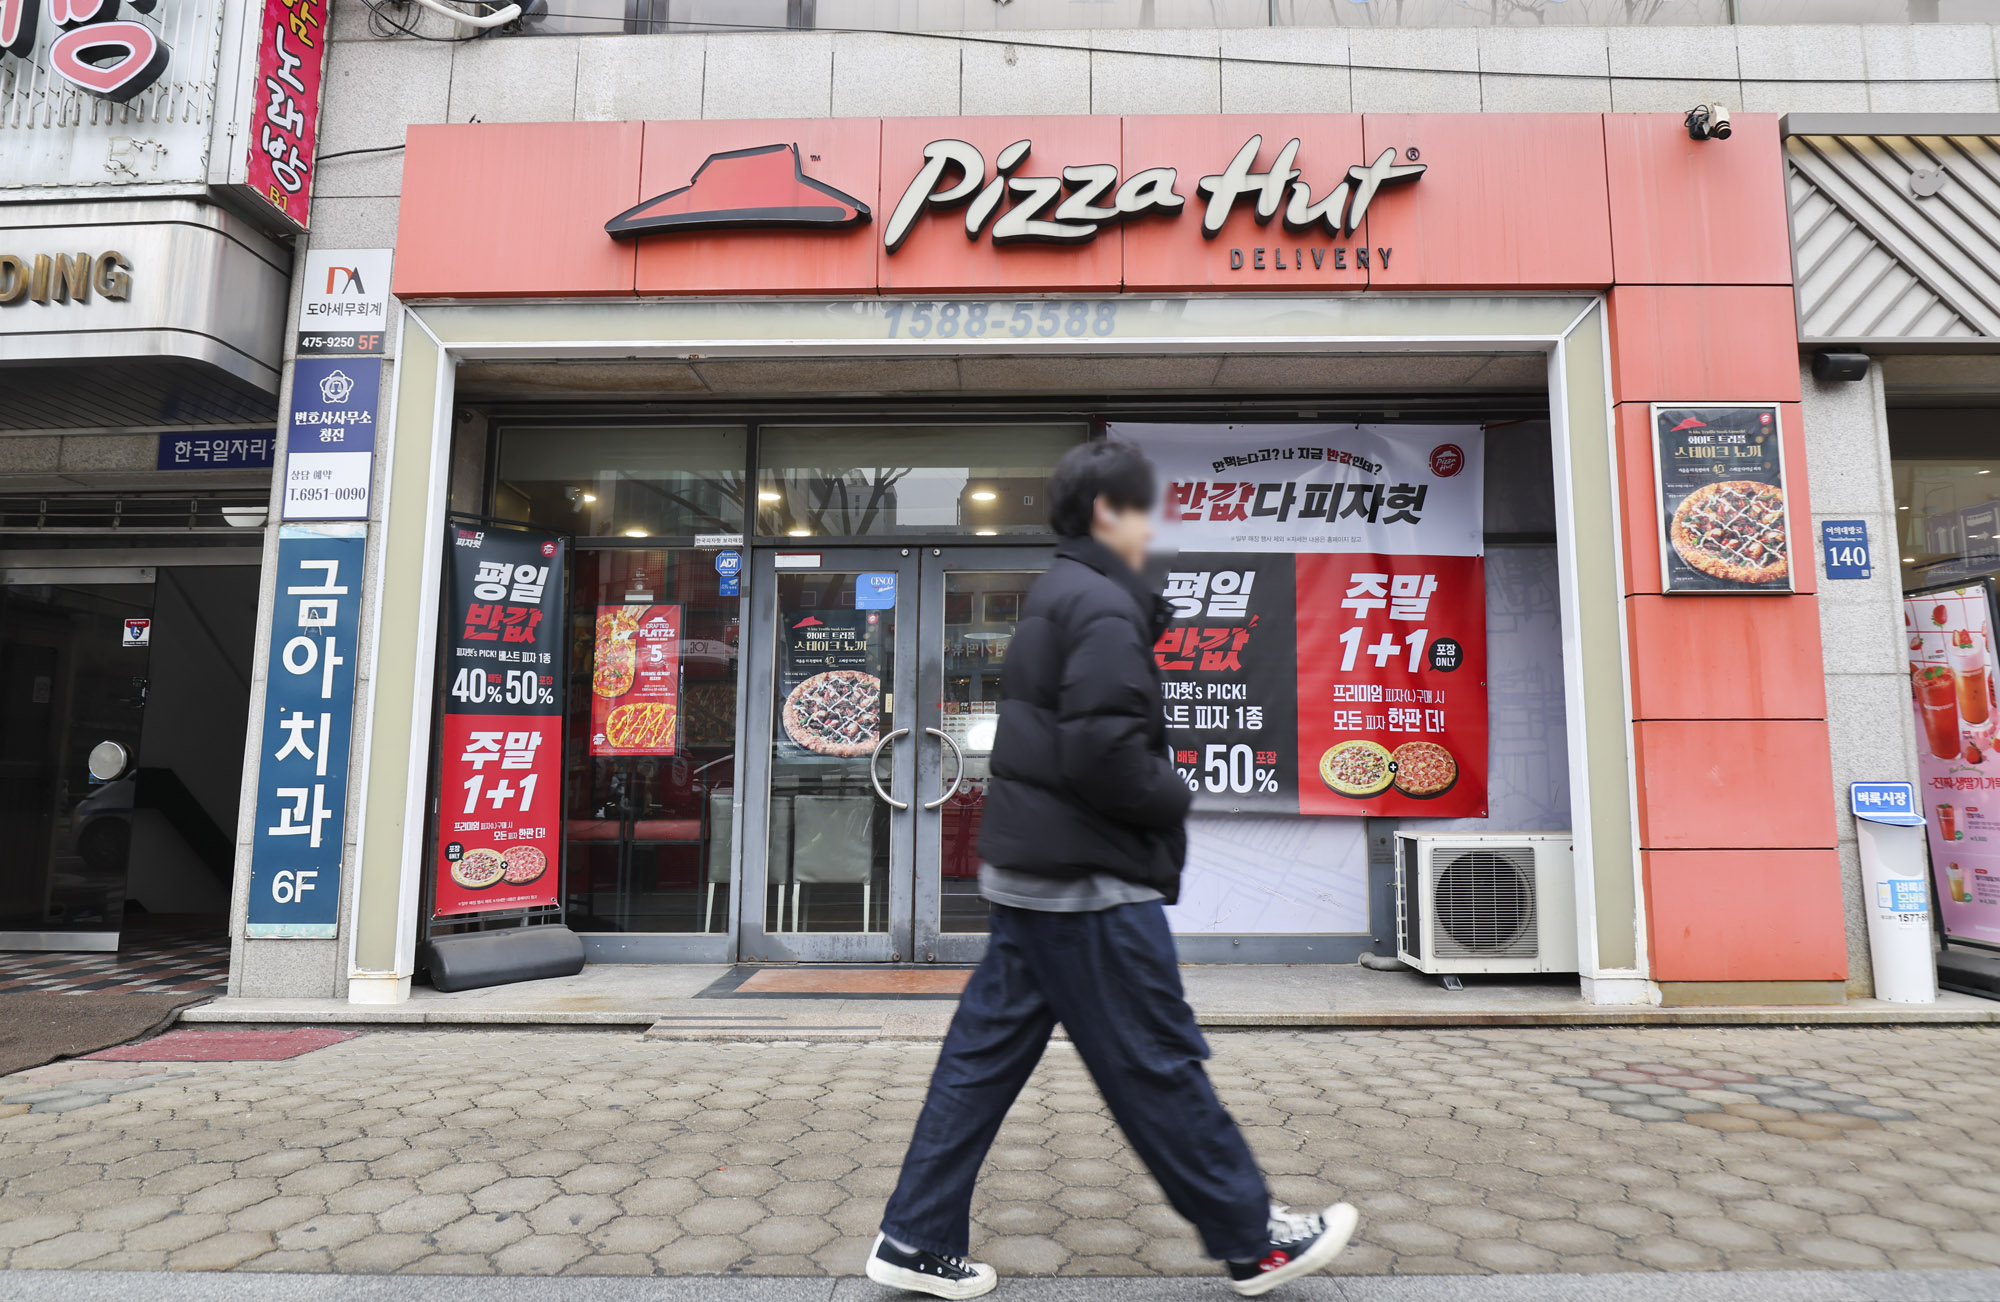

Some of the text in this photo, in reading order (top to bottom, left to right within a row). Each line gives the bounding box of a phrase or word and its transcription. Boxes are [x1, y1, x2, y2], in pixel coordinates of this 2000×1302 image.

[270, 187, 288, 211] B1
[885, 138, 1185, 255] Pizza
[1197, 134, 1427, 239] Hut
[1231, 247, 1392, 270] DELIVERY
[306, 302, 381, 317] 도아세무회계
[884, 301, 1118, 339] 1588-5588
[302, 335, 379, 350] 475-9250 5F
[295, 411, 372, 425] 변호사사무소
[319, 428, 345, 442] 청진
[1212, 447, 1383, 476] 안먹는다고? 나 지금 반값인데?
[1675, 446, 1730, 459] 스테이크
[291, 470, 332, 481] 상담 예약
[289, 487, 366, 501] T.6951-0090
[1164, 482, 1428, 525] 반값다 피자헛
[456, 538, 481, 549] 피자헛
[720, 558, 737, 568] ADT
[1829, 547, 1866, 566] 140
[474, 561, 549, 604] 평일
[871, 576, 894, 585] CESCO
[1163, 571, 1256, 618] 평일
[1341, 573, 1438, 621] 주말
[463, 603, 543, 643] 반값
[640, 629, 675, 637] FLATZZ
[794, 641, 841, 651] 스테이크
[1153, 627, 1250, 671] 반값
[1339, 626, 1429, 673] 1+1
[1436, 644, 1456, 656] 포장
[479, 649, 497, 658] PICK!
[499, 651, 520, 662] 베스트
[522, 652, 536, 663] 피자
[539, 653, 551, 664] 1종
[1436, 657, 1456, 667] ONLY
[452, 668, 553, 704] 40% 50%
[1207, 683, 1247, 700] PICK!
[1333, 684, 1383, 703] 프리미엄
[1435, 690, 1445, 703] 시
[268, 560, 348, 848] 금아치과
[1194, 706, 1230, 730] 피자
[1235, 706, 1263, 730] 1종
[1334, 708, 1445, 733] 모든 피자 한판 더!
[461, 732, 542, 769] 주말
[1177, 751, 1198, 764] 배달
[1256, 751, 1277, 764] 포장
[1204, 743, 1279, 794] 50%
[463, 774, 538, 814] 1+1
[1857, 792, 1907, 806] 벼룩시장
[454, 822, 479, 831] 프리미엄
[493, 831, 507, 840] 모든
[519, 829, 534, 839] 한판
[535, 828, 546, 838] 더!
[272, 871, 318, 903] 6F
